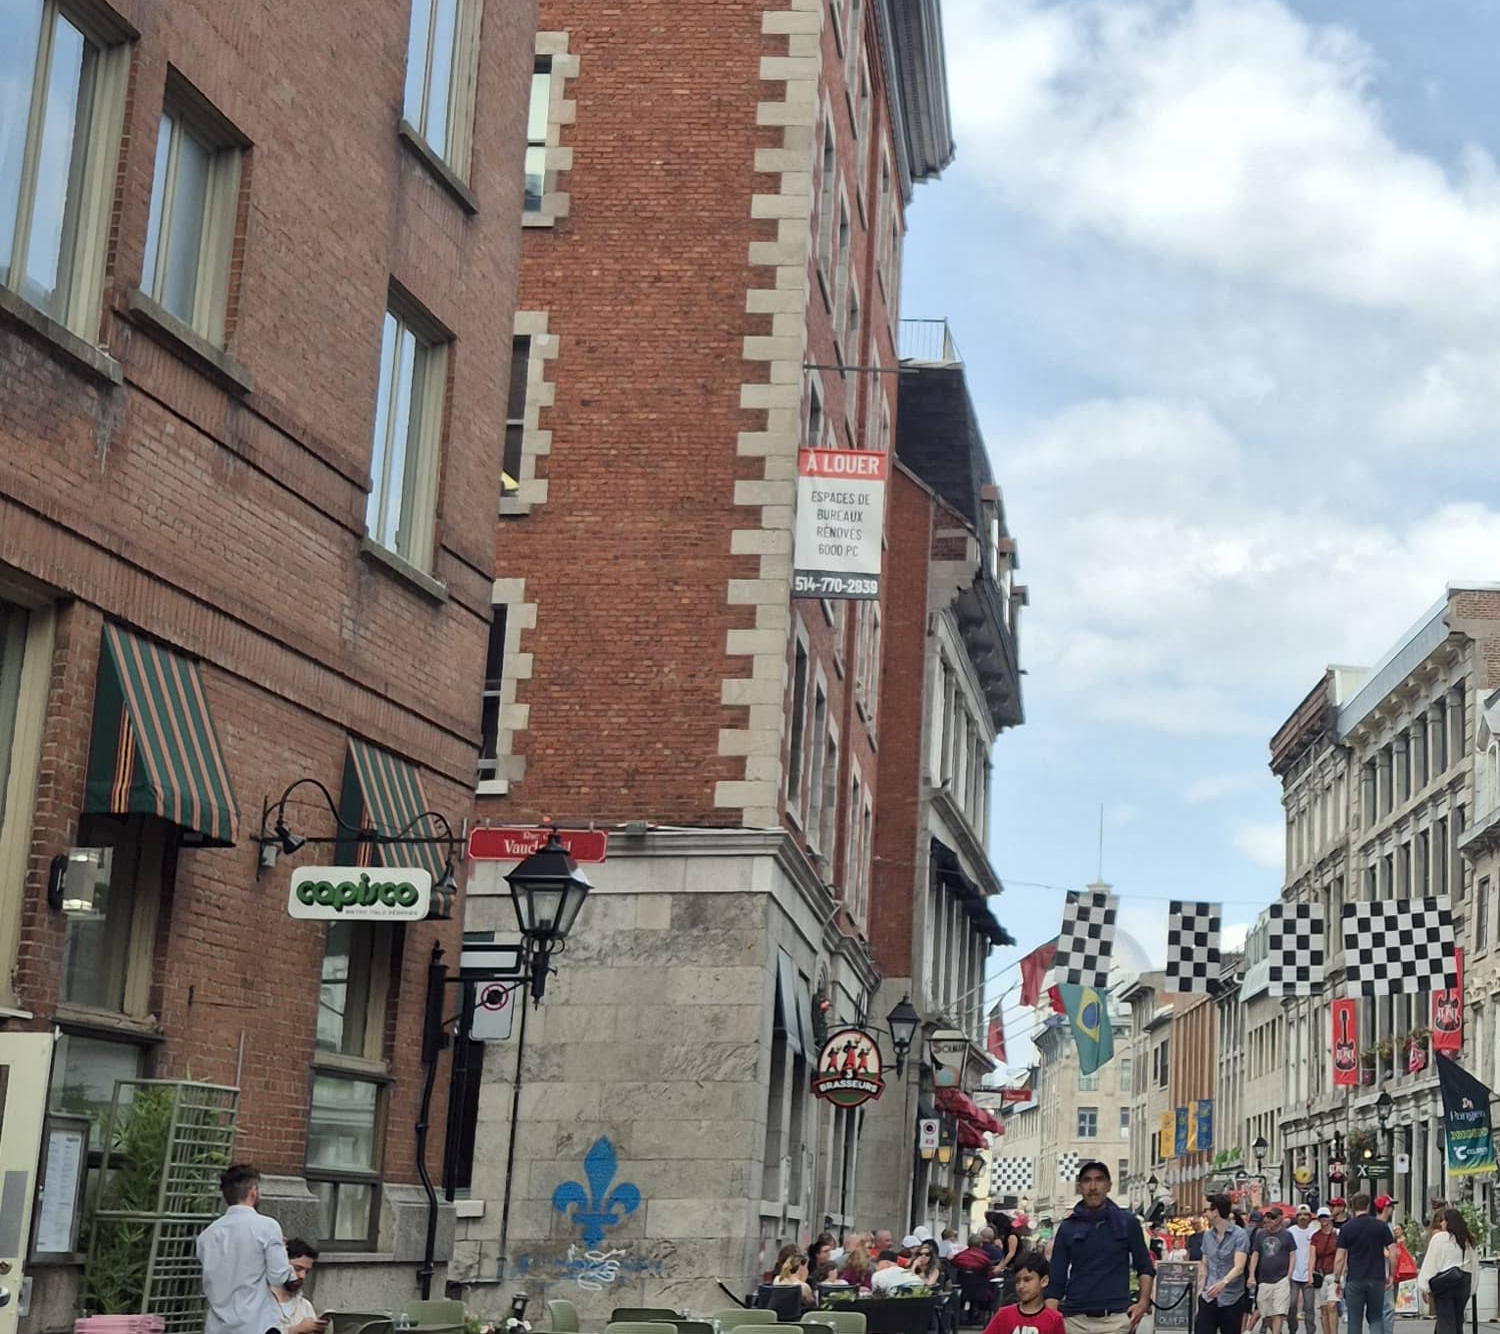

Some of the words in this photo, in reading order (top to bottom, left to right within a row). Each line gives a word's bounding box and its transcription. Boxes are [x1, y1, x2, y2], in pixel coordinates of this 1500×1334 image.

[807, 449, 817, 471] À
[823, 454, 880, 475] LOUER
[811, 490, 855, 505] ESPACES
[858, 493, 871, 506] DE
[817, 508, 864, 523] BUREAUX
[818, 544, 843, 557] 6000
[846, 545, 859, 557] PC
[296, 872, 420, 913] capisco
[819, 1079, 878, 1095] BRASSEURS
